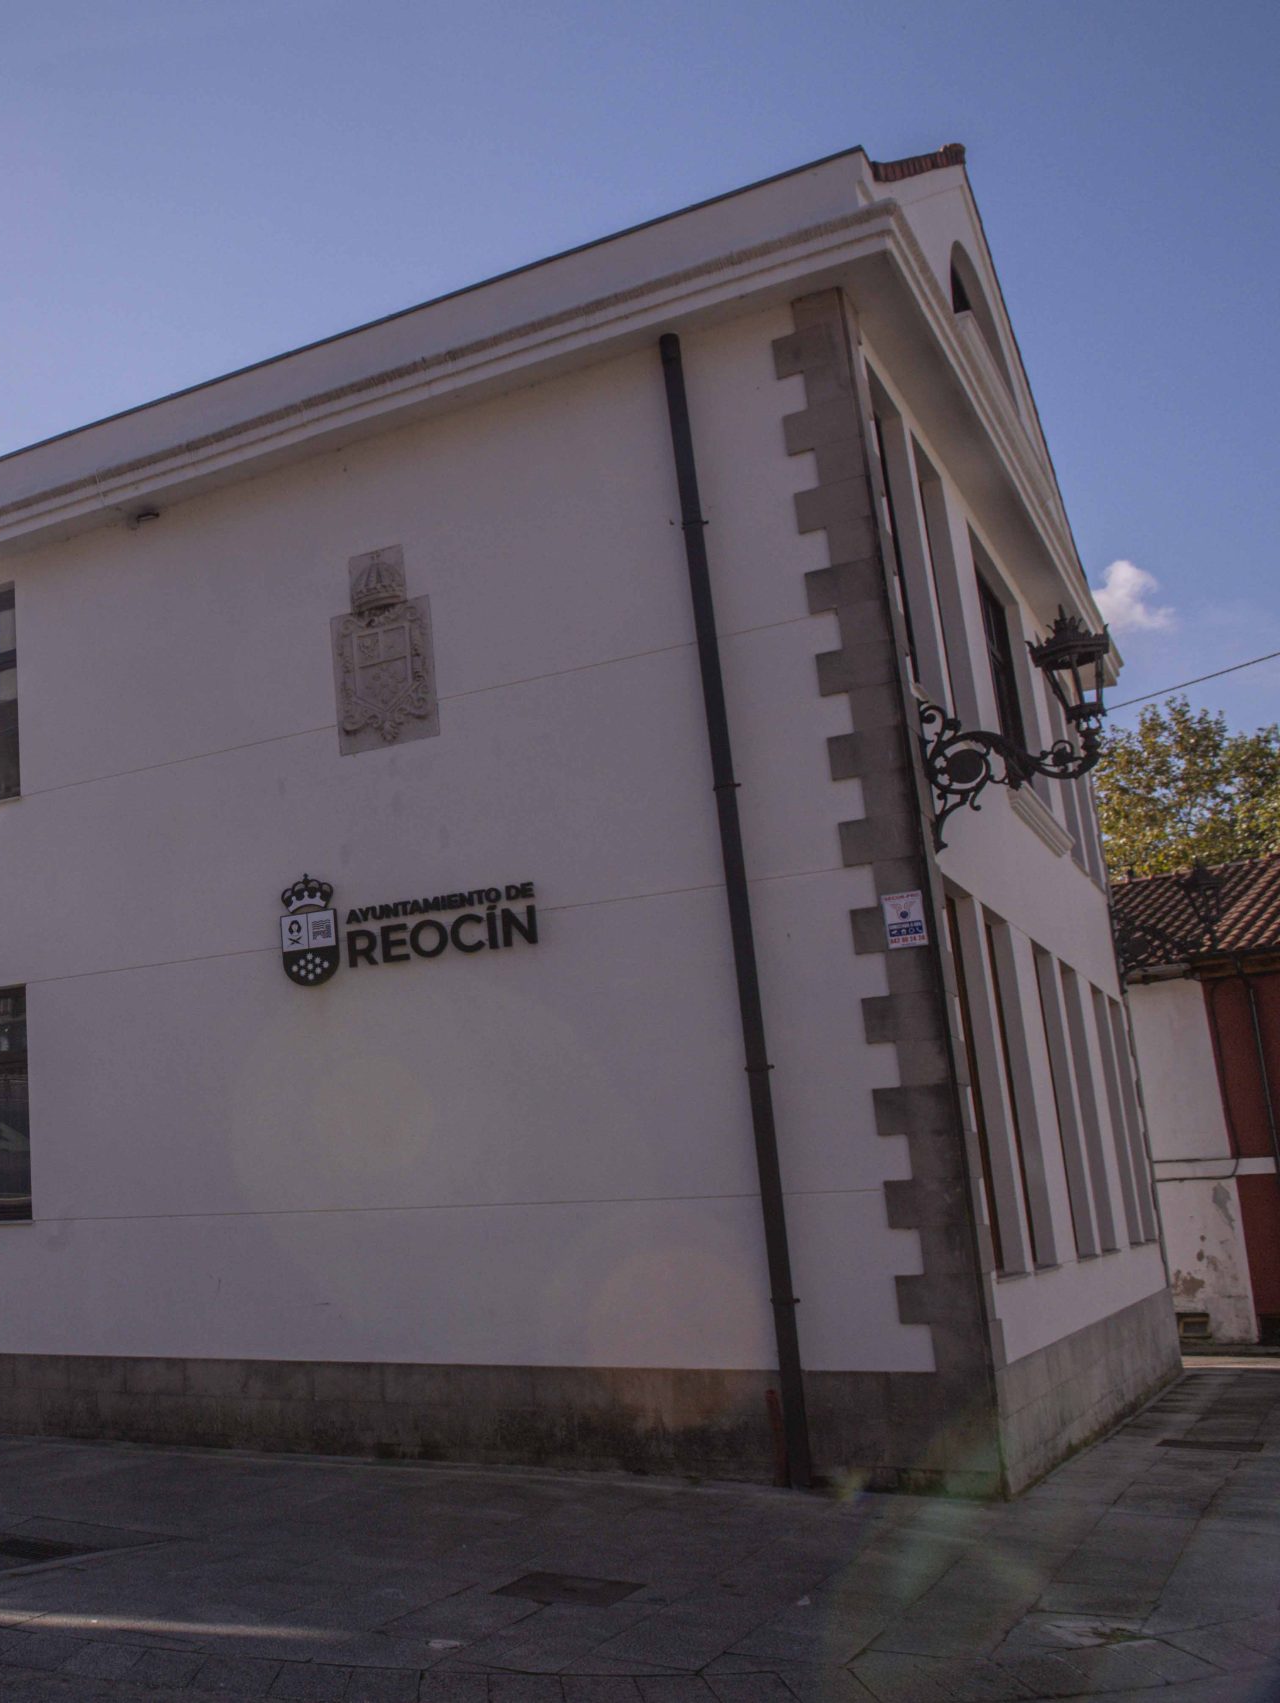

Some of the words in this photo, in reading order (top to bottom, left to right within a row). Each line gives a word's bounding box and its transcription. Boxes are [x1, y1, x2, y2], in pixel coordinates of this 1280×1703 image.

[345, 887, 502, 925] AYUNTAMIENTO
[504, 881, 535, 902] DE
[346, 904, 539, 968] REOCÍN
